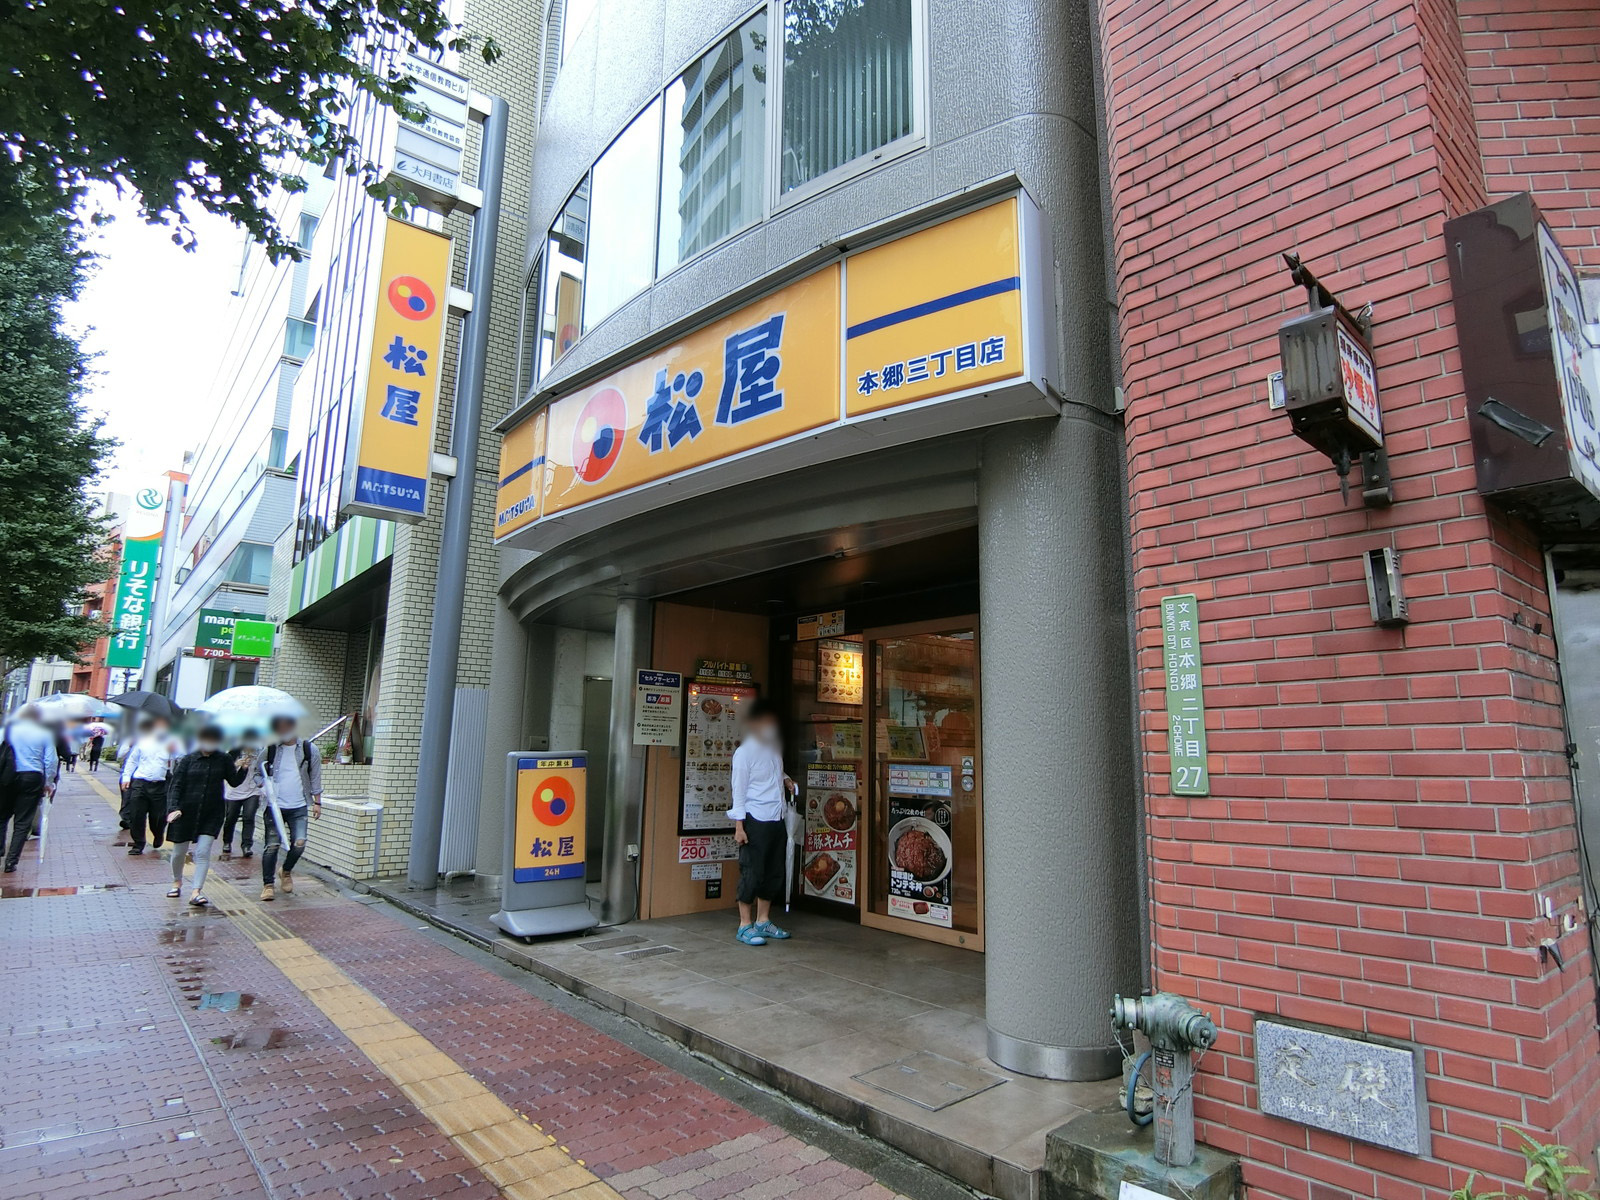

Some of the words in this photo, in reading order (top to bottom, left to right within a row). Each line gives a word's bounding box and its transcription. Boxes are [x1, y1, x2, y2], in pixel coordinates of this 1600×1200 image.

[412, 164, 454, 190] 大月書店
[856, 336, 1006, 396] 本郷三丁目店
[380, 335, 428, 427] 松屋
[636, 311, 788, 456] 松屋
[1567, 366, 1596, 431] PUB
[361, 480, 421, 500] MATSUYA
[497, 494, 536, 527] MATSUYA
[116, 560, 149, 650] りそな銀行
[1165, 603, 1176, 632] BUNKYO
[1167, 635, 1177, 650] CITY
[1168, 653, 1179, 691] HONGO
[1172, 714, 1184, 757] 2-CHOME
[1176, 766, 1202, 788] 27
[530, 836, 575, 858] 松屋
[681, 846, 707, 860] 290
[813, 833, 853, 850] 豚キムチ
[544, 868, 560, 876] 24H
